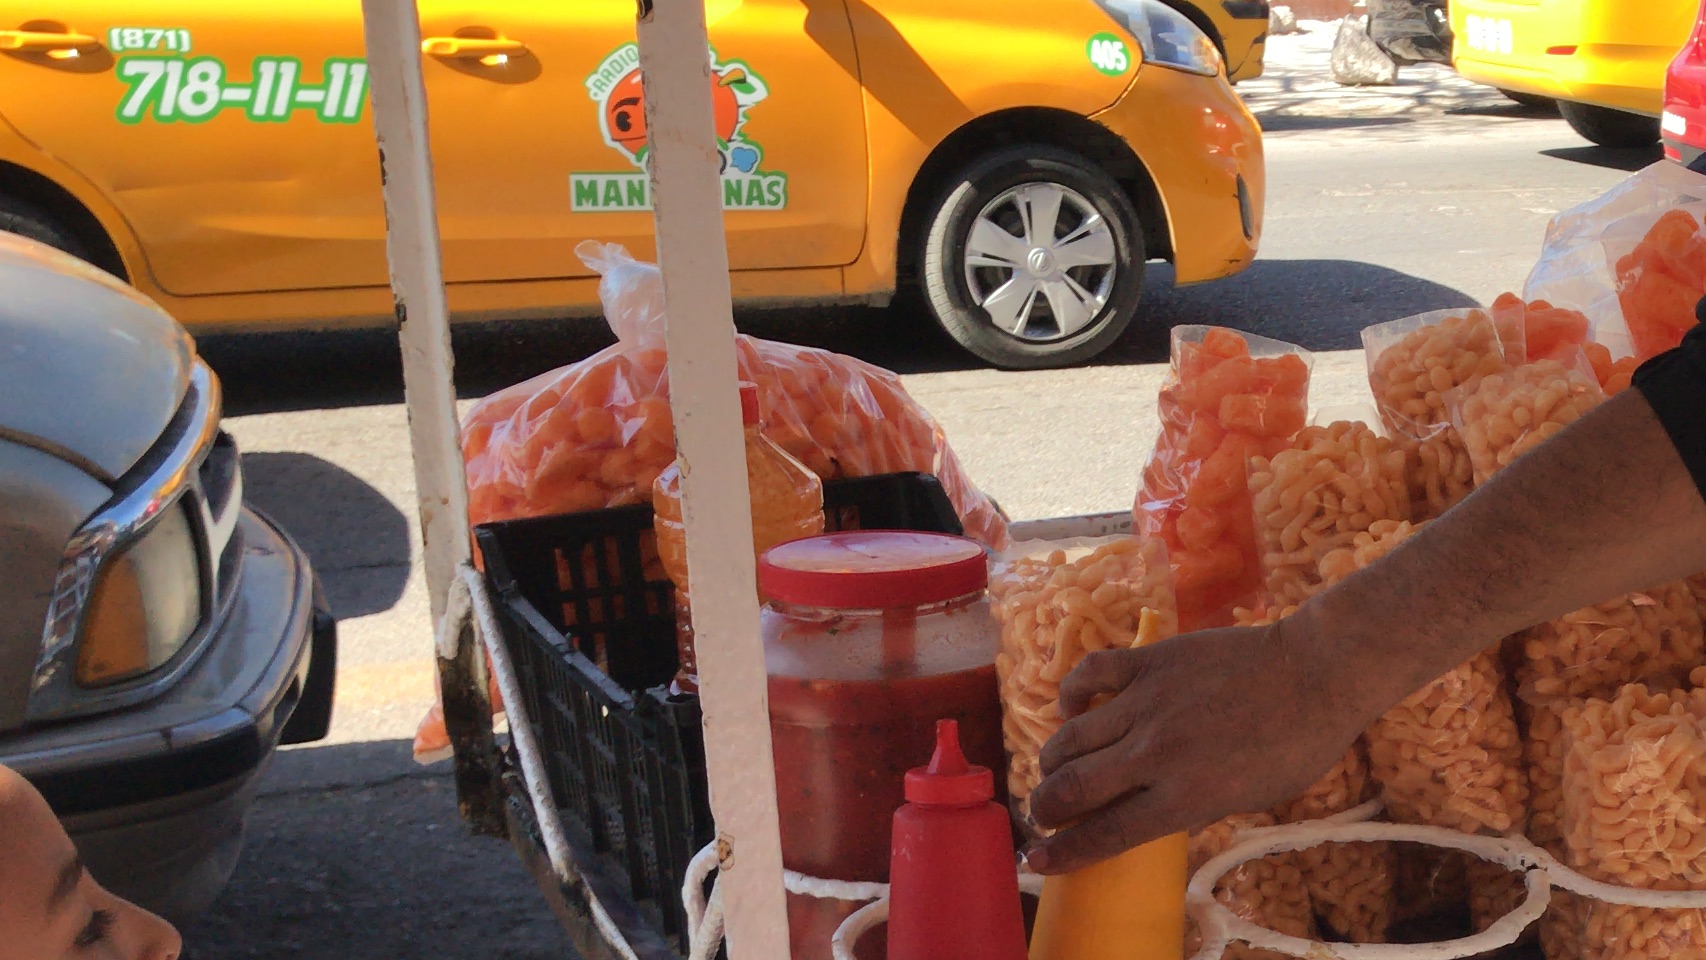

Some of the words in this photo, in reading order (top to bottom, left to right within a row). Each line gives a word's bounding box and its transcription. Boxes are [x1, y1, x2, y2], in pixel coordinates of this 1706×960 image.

[110, 27, 191, 53] (871)
[121, 60, 368, 117] 718-11-11
[592, 47, 640, 93] RADIO
[574, 178, 781, 207] MANNAS
